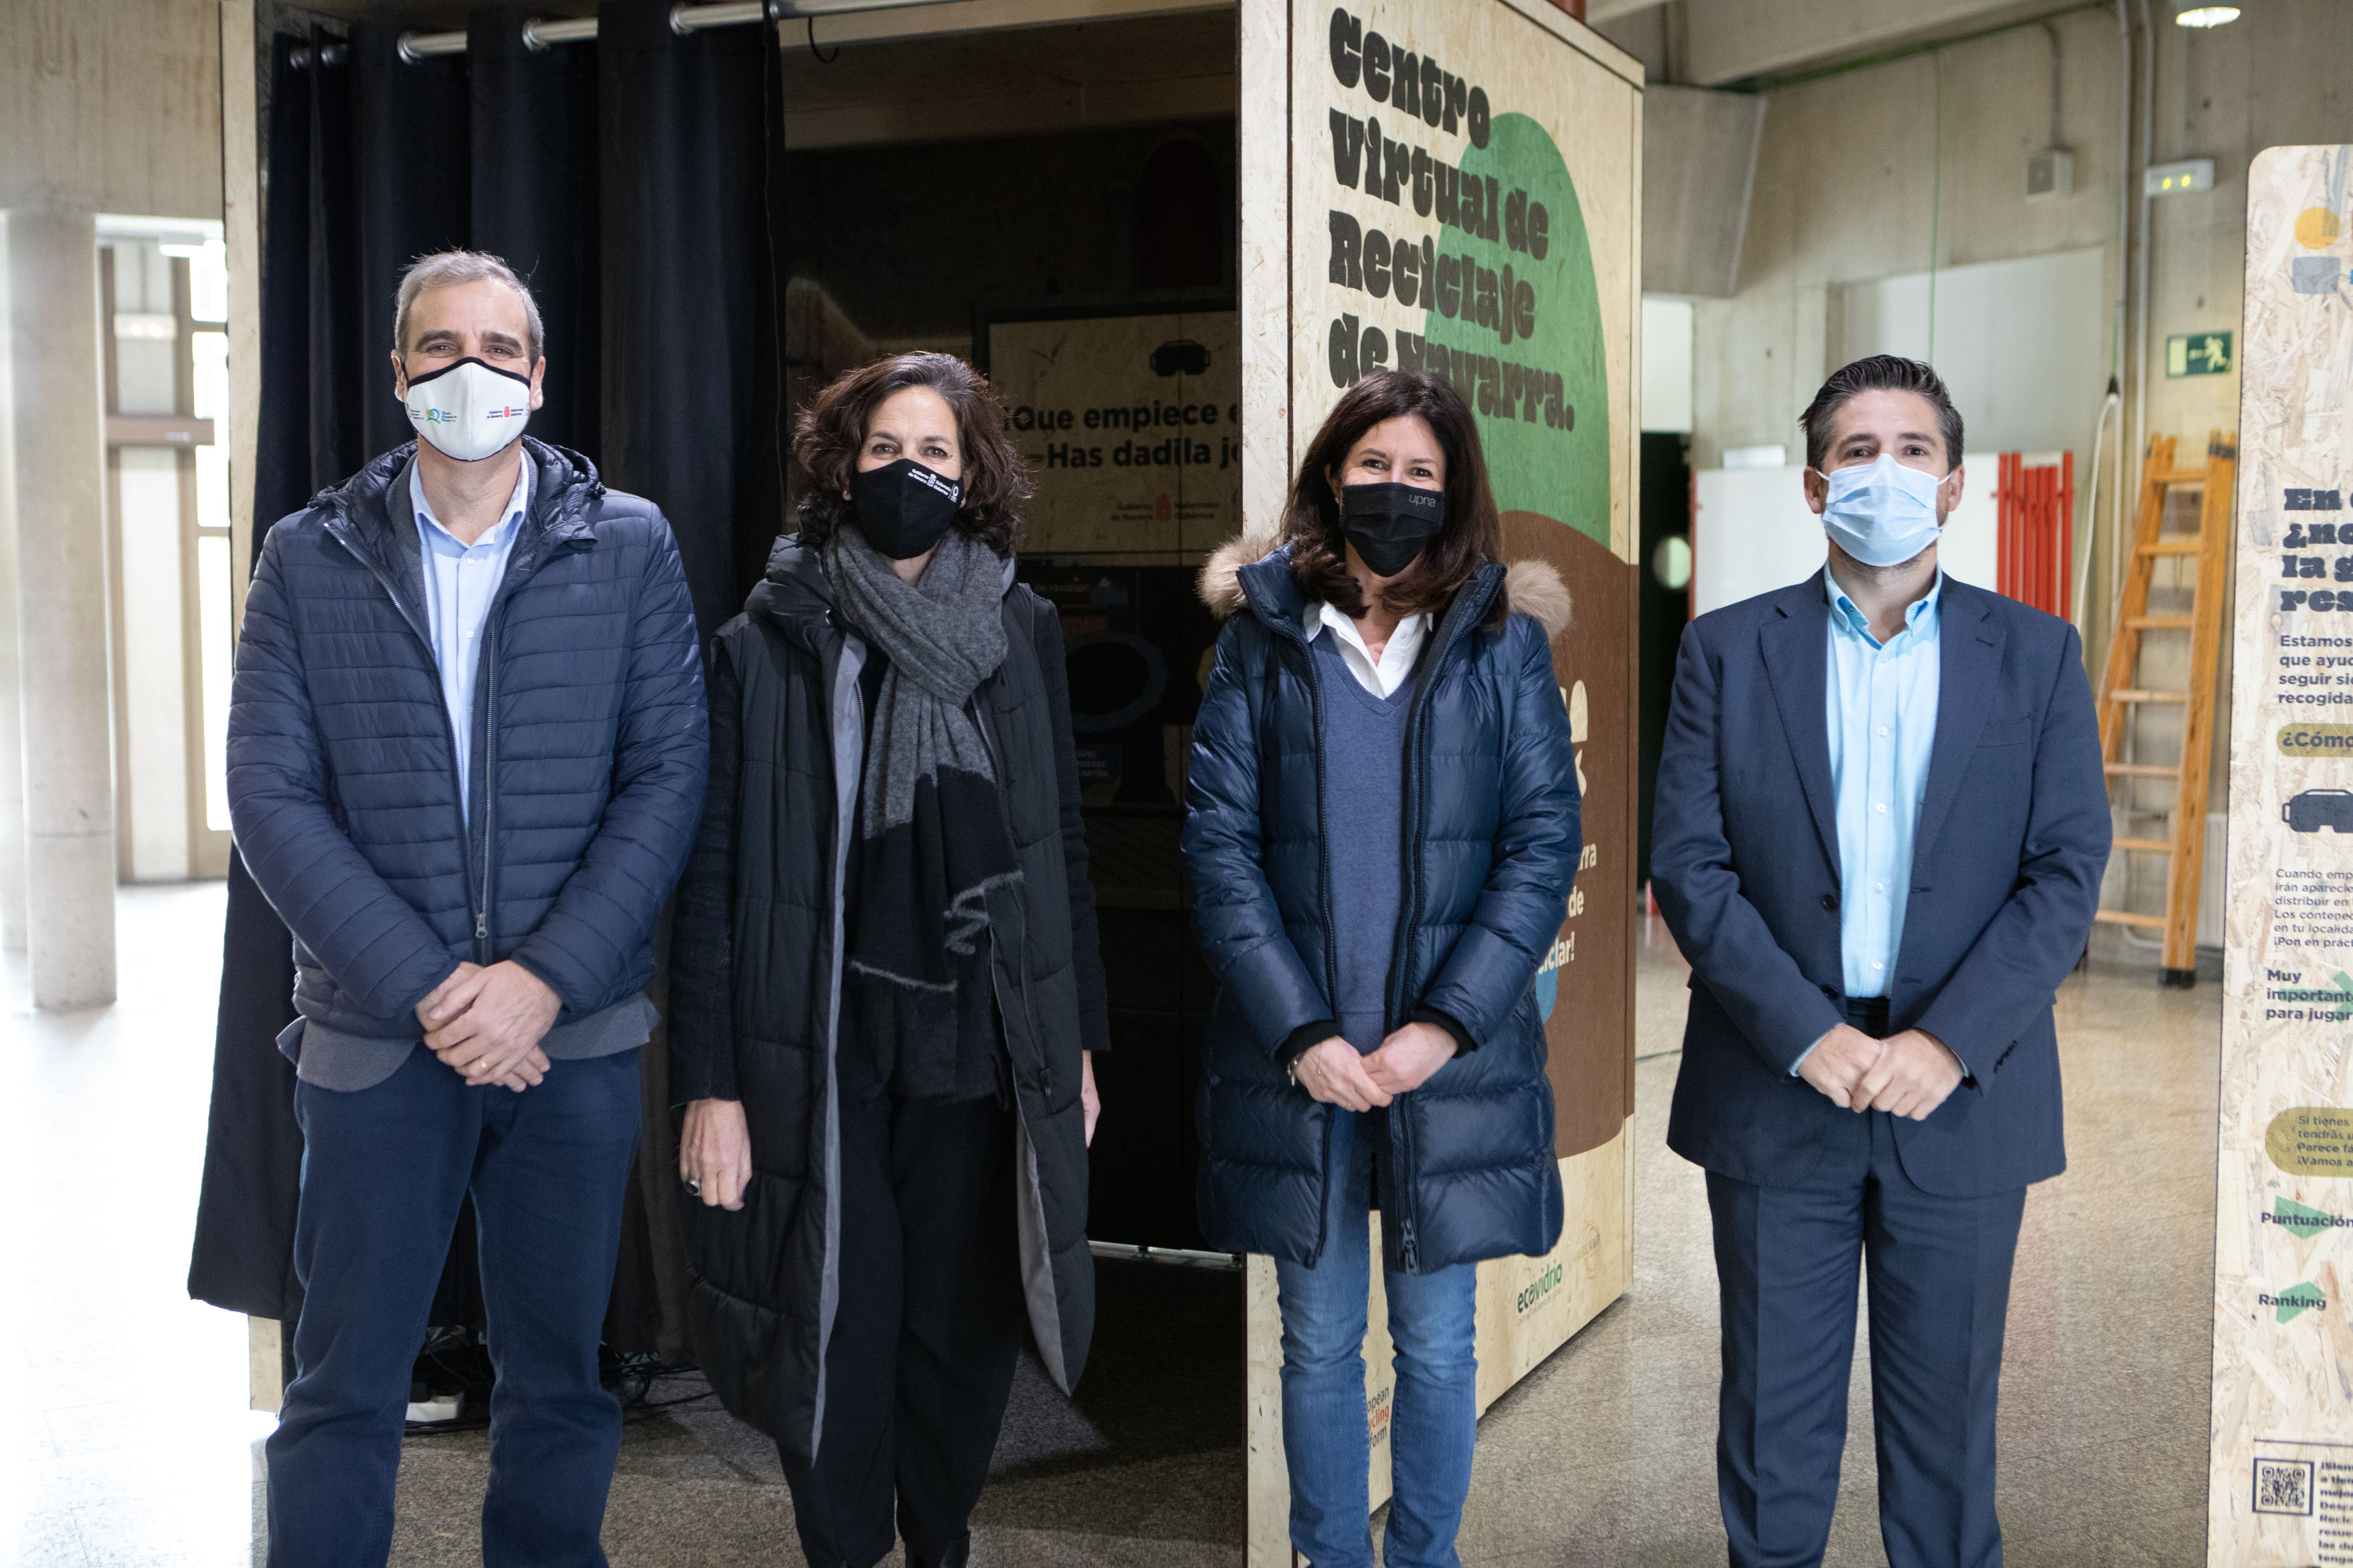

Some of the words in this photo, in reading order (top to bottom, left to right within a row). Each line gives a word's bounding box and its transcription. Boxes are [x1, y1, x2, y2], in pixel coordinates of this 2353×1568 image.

[1330, 7, 1490, 149] Centro
[1330, 107, 1499, 243] Virtual
[1505, 187, 1549, 260] de
[1330, 209, 1535, 345] Reciclaje
[1329, 313, 1388, 388] de
[1084, 401, 1219, 432] empiece
[1049, 443, 1103, 468] Has
[1113, 438, 1211, 467] dadila
[1409, 494, 1436, 507] upna
[2284, 489, 2342, 510] En
[2282, 555, 2326, 578] la
[2281, 635, 2353, 647] Estamos
[2279, 656, 2311, 668] que
[2279, 673, 2332, 687] seguir
[2278, 693, 2353, 706] recogida
[1578, 843, 1597, 871] rra
[2276, 869, 2322, 879] Cuando
[2275, 883, 2298, 891] irán
[1568, 885, 1584, 918] de
[2274, 896, 2330, 906] distribuir
[2274, 910, 2296, 919] Los
[2293, 924, 2304, 932] tu
[2267, 969, 2302, 984] Muy
[2266, 1009, 2303, 1020] para
[2308, 1008, 2353, 1022] jugar
[2299, 1115, 2309, 1125] Si
[2313, 1116, 2349, 1126] tienes
[2297, 1142, 2339, 1152] Parece
[1518, 1259, 1562, 1313] ecovidrio
[2258, 1294, 2326, 1310] Ranking
